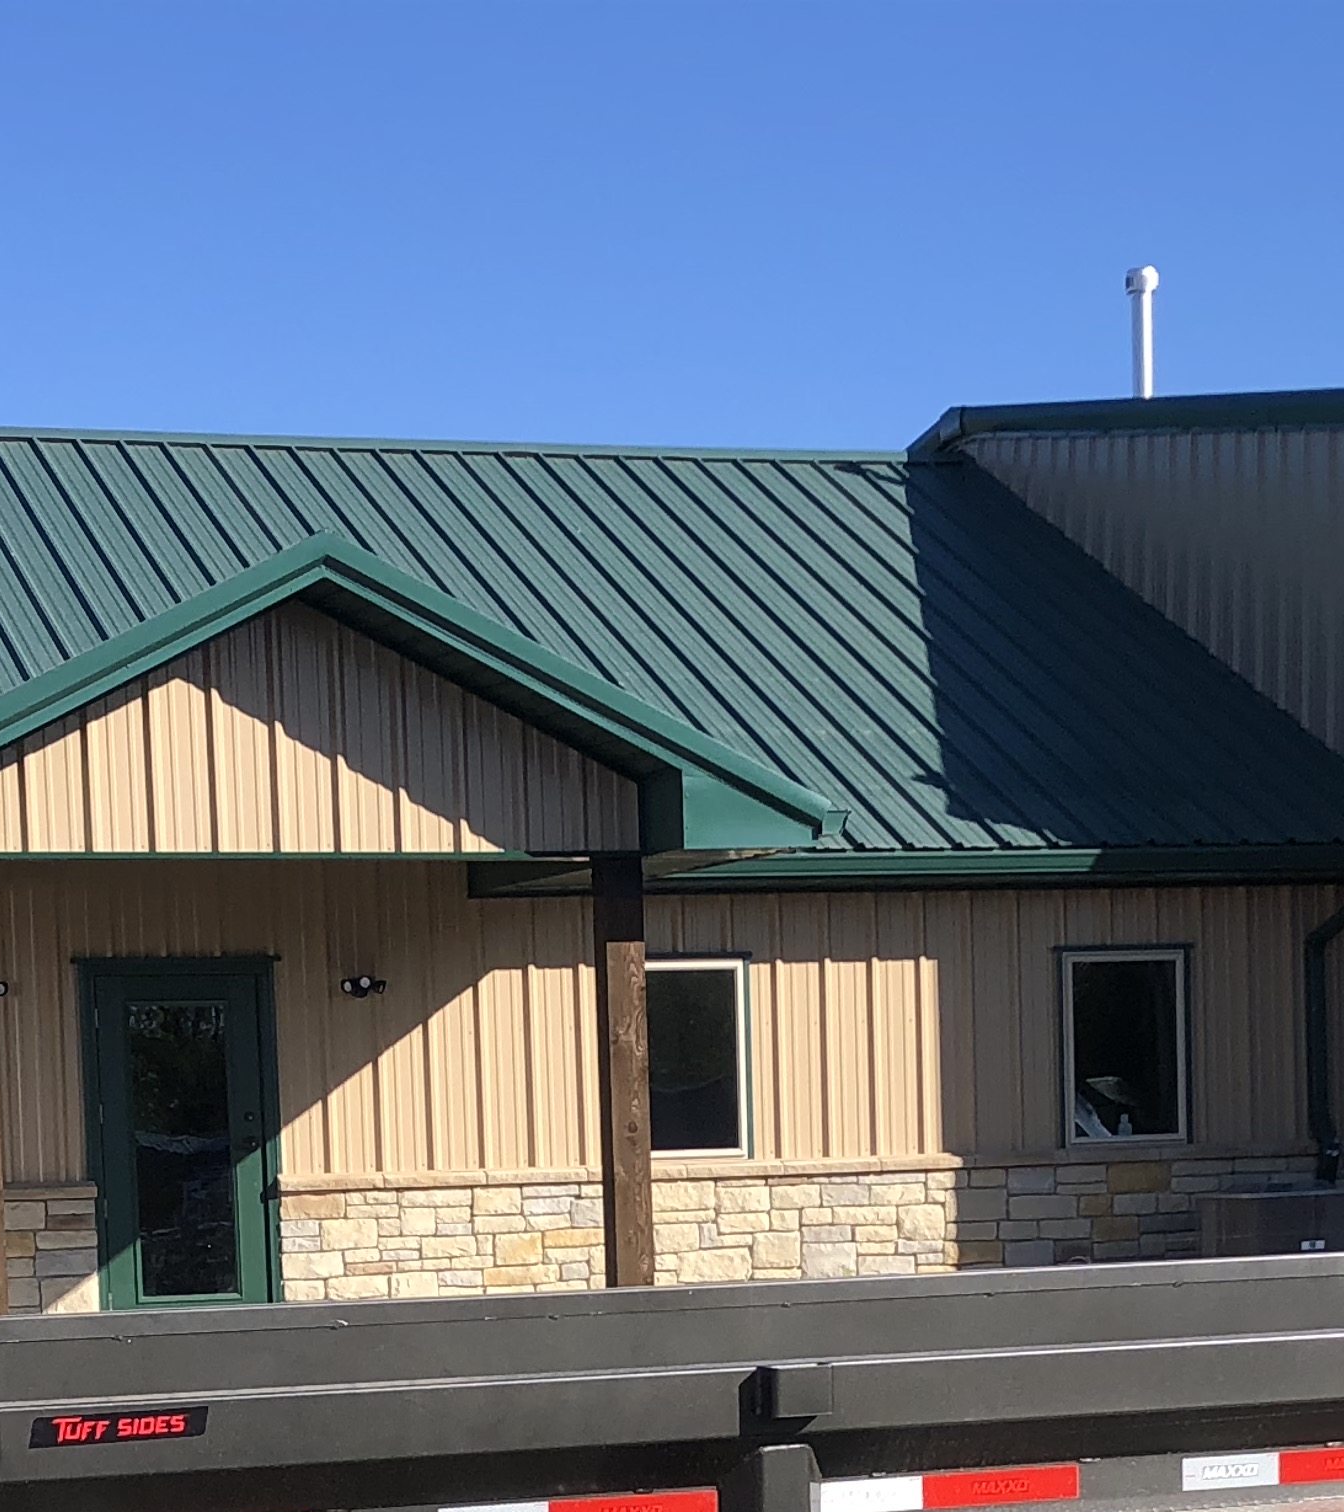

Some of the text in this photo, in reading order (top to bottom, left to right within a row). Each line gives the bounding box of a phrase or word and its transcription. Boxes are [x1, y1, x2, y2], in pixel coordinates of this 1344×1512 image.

[51, 1413, 186, 1442] TUFF SIDES
[1201, 1463, 1259, 1480] MAXXD
[971, 1478, 1030, 1495] MAXXD
